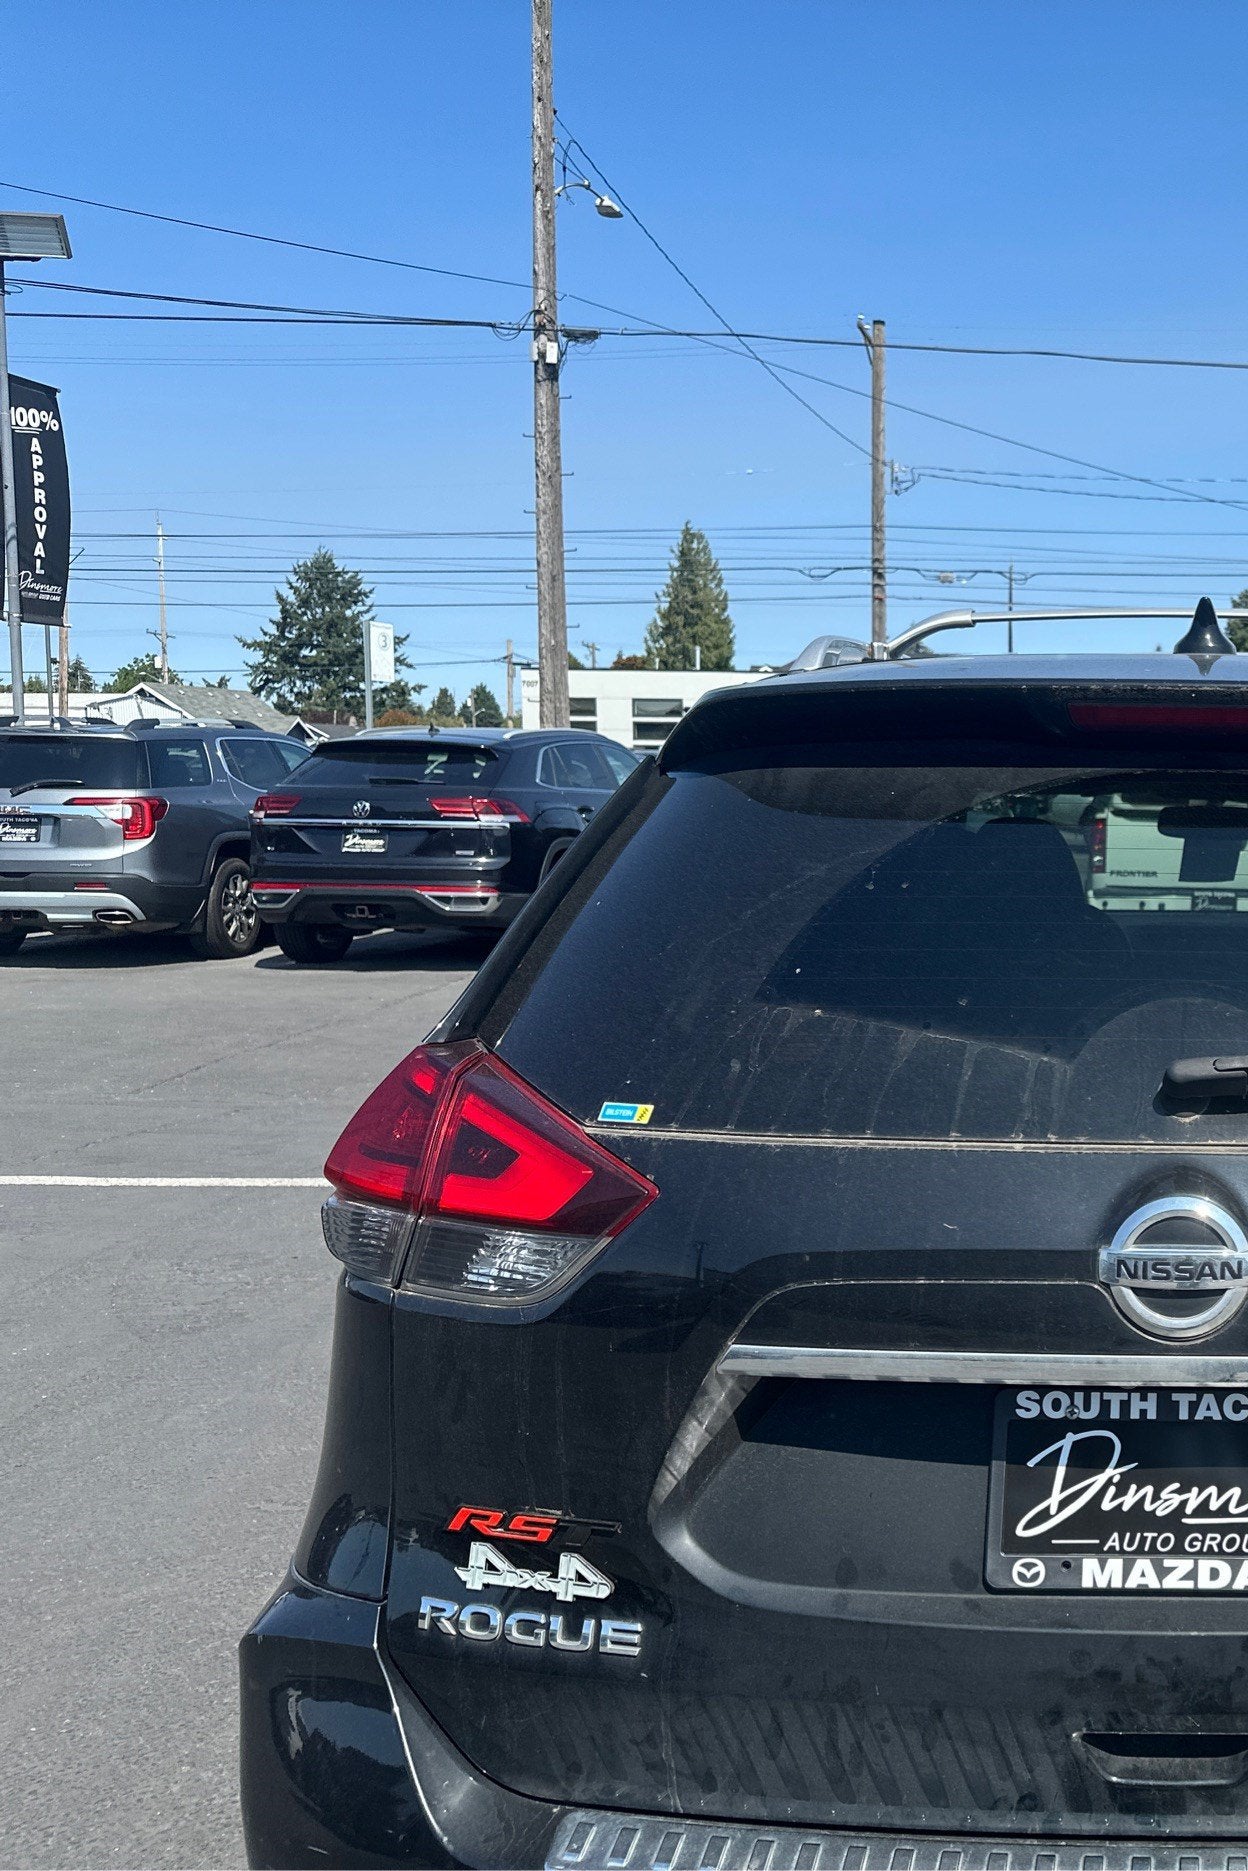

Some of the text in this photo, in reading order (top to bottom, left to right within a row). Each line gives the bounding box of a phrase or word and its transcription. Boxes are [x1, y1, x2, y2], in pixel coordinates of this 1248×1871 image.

[11, 406, 60, 433] 100%
[30, 437, 47, 575] APPROVAL
[18, 570, 63, 592] Dinsmore
[1116, 1259, 1243, 1281] NISSAN
[1015, 1390, 1157, 1421] SOUTH
[1103, 1532, 1175, 1552] AUTO
[418, 1596, 643, 1656] ROGUE
